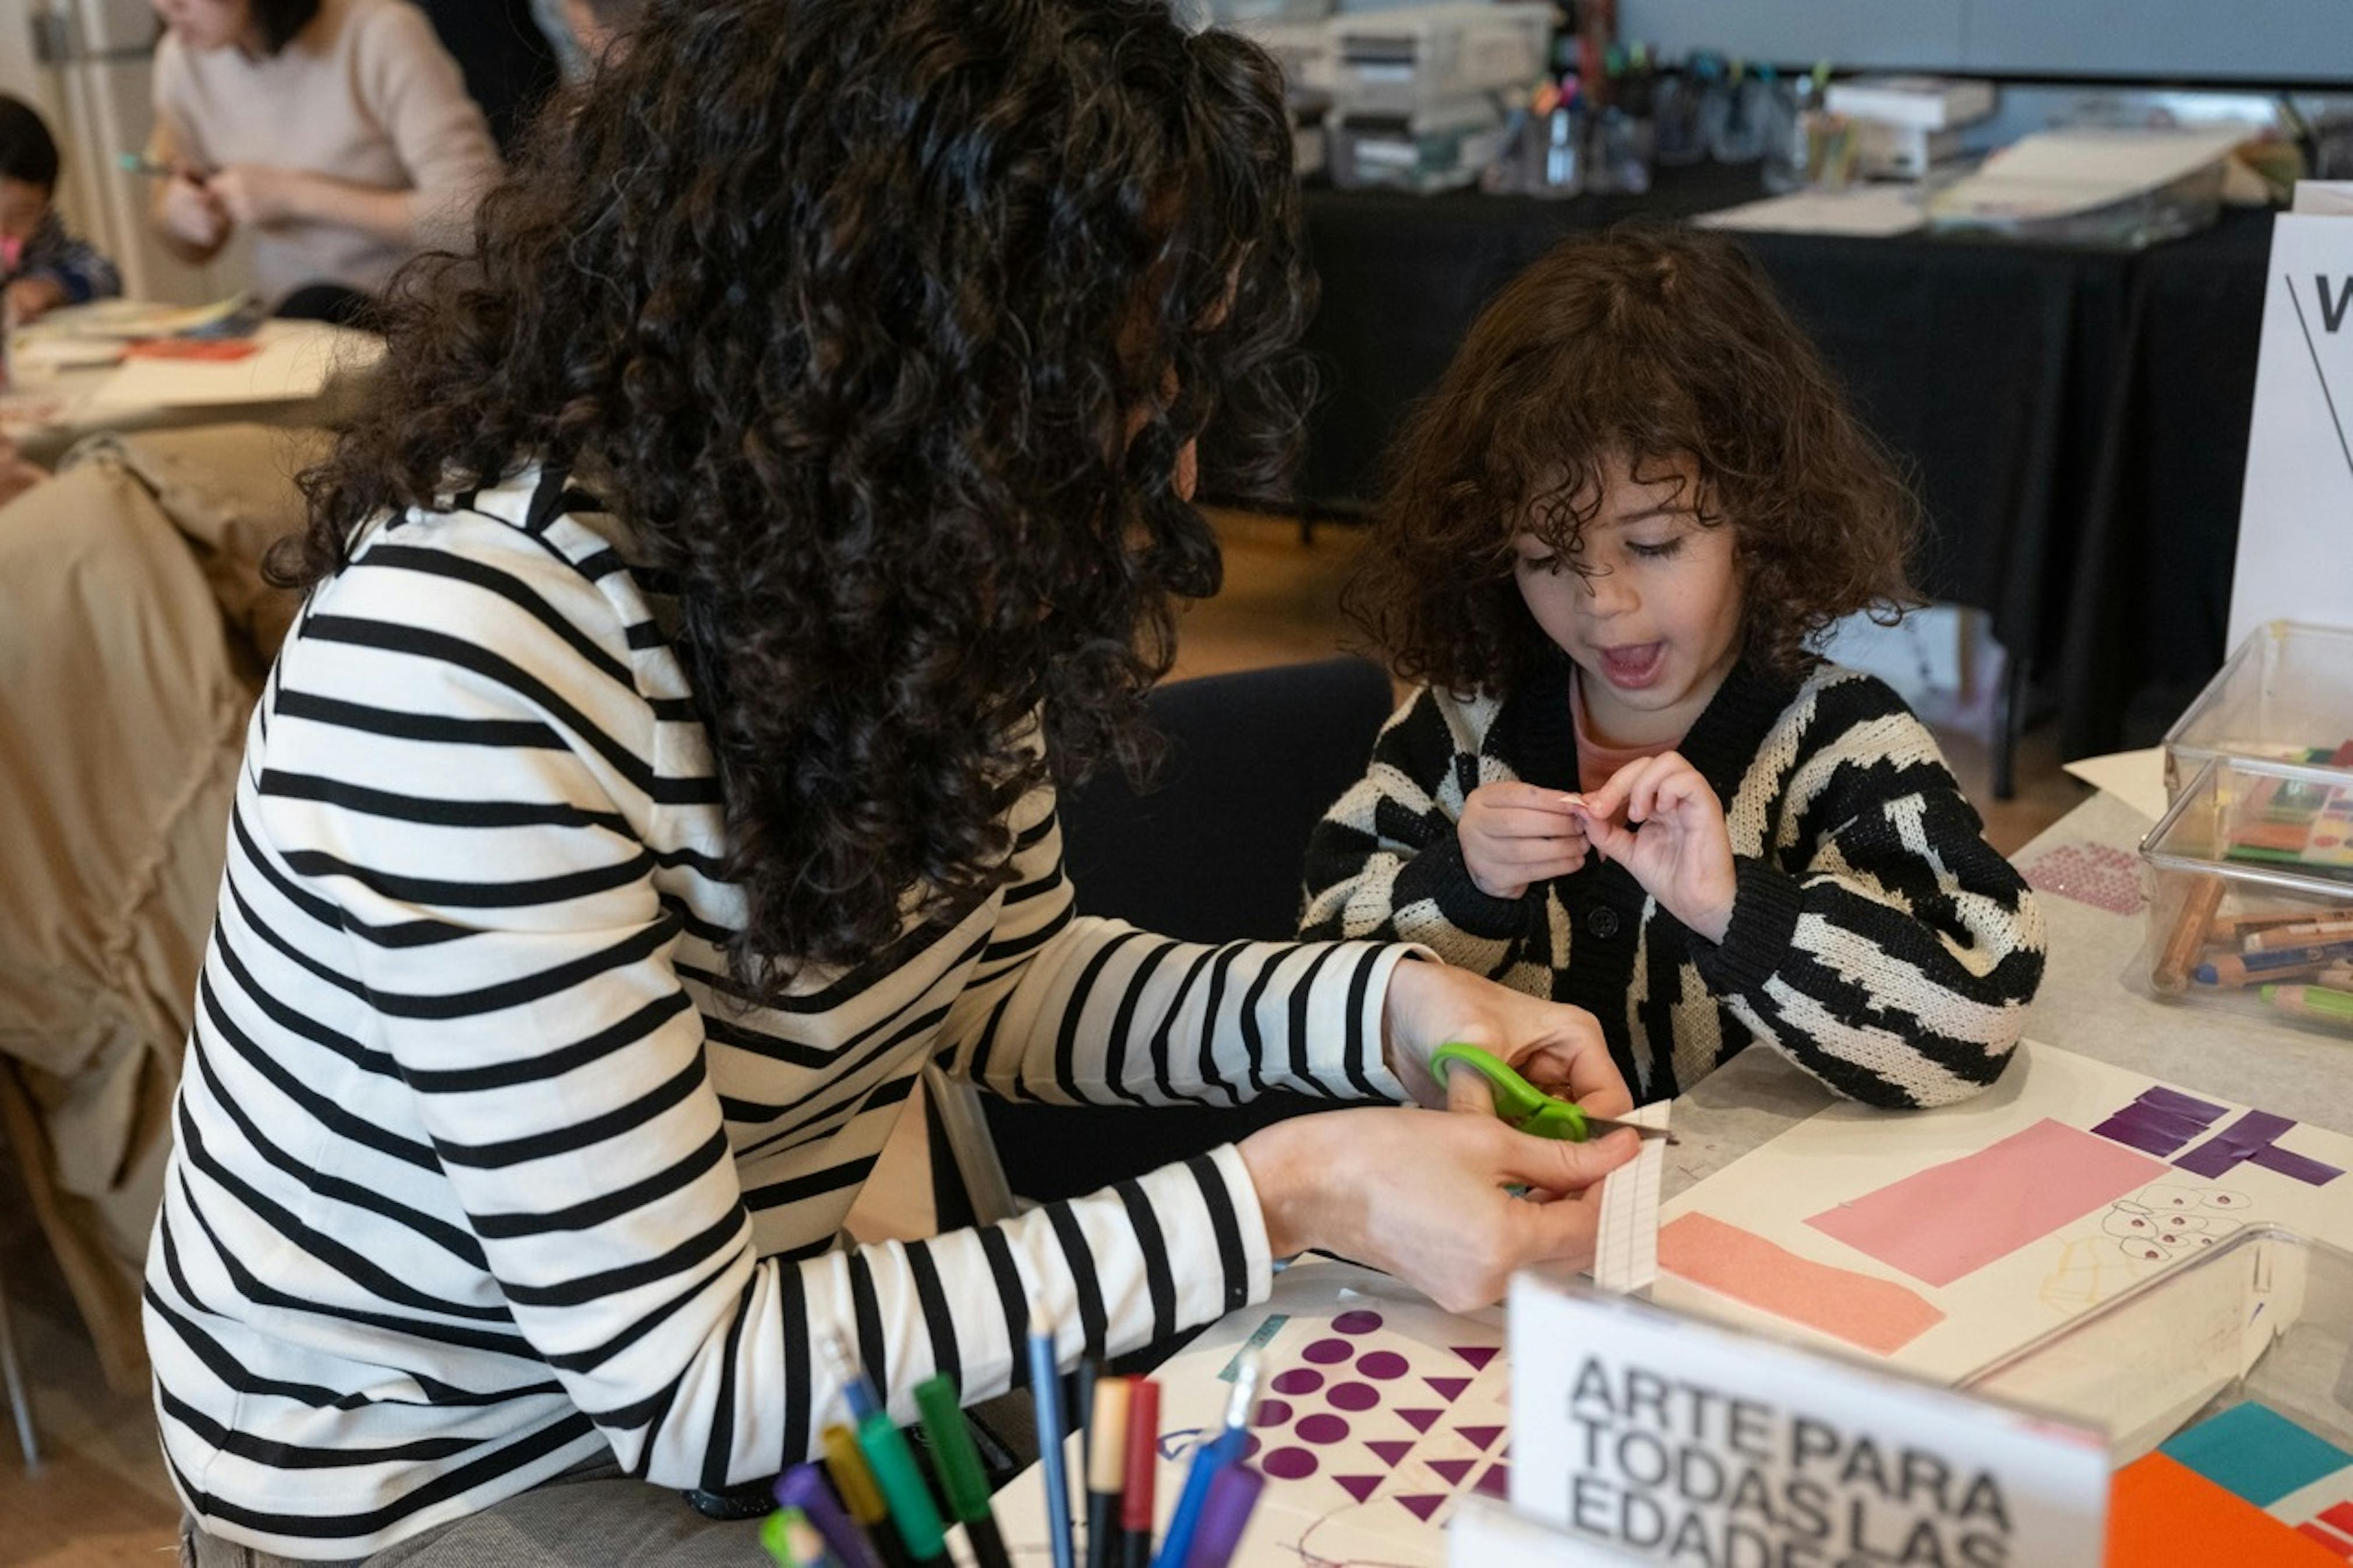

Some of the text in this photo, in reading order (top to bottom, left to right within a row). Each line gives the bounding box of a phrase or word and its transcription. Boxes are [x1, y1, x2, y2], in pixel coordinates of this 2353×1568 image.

[1570, 1355, 2013, 1535] ARTE PARA
[1571, 1412, 2010, 1568] TODAS LAS
